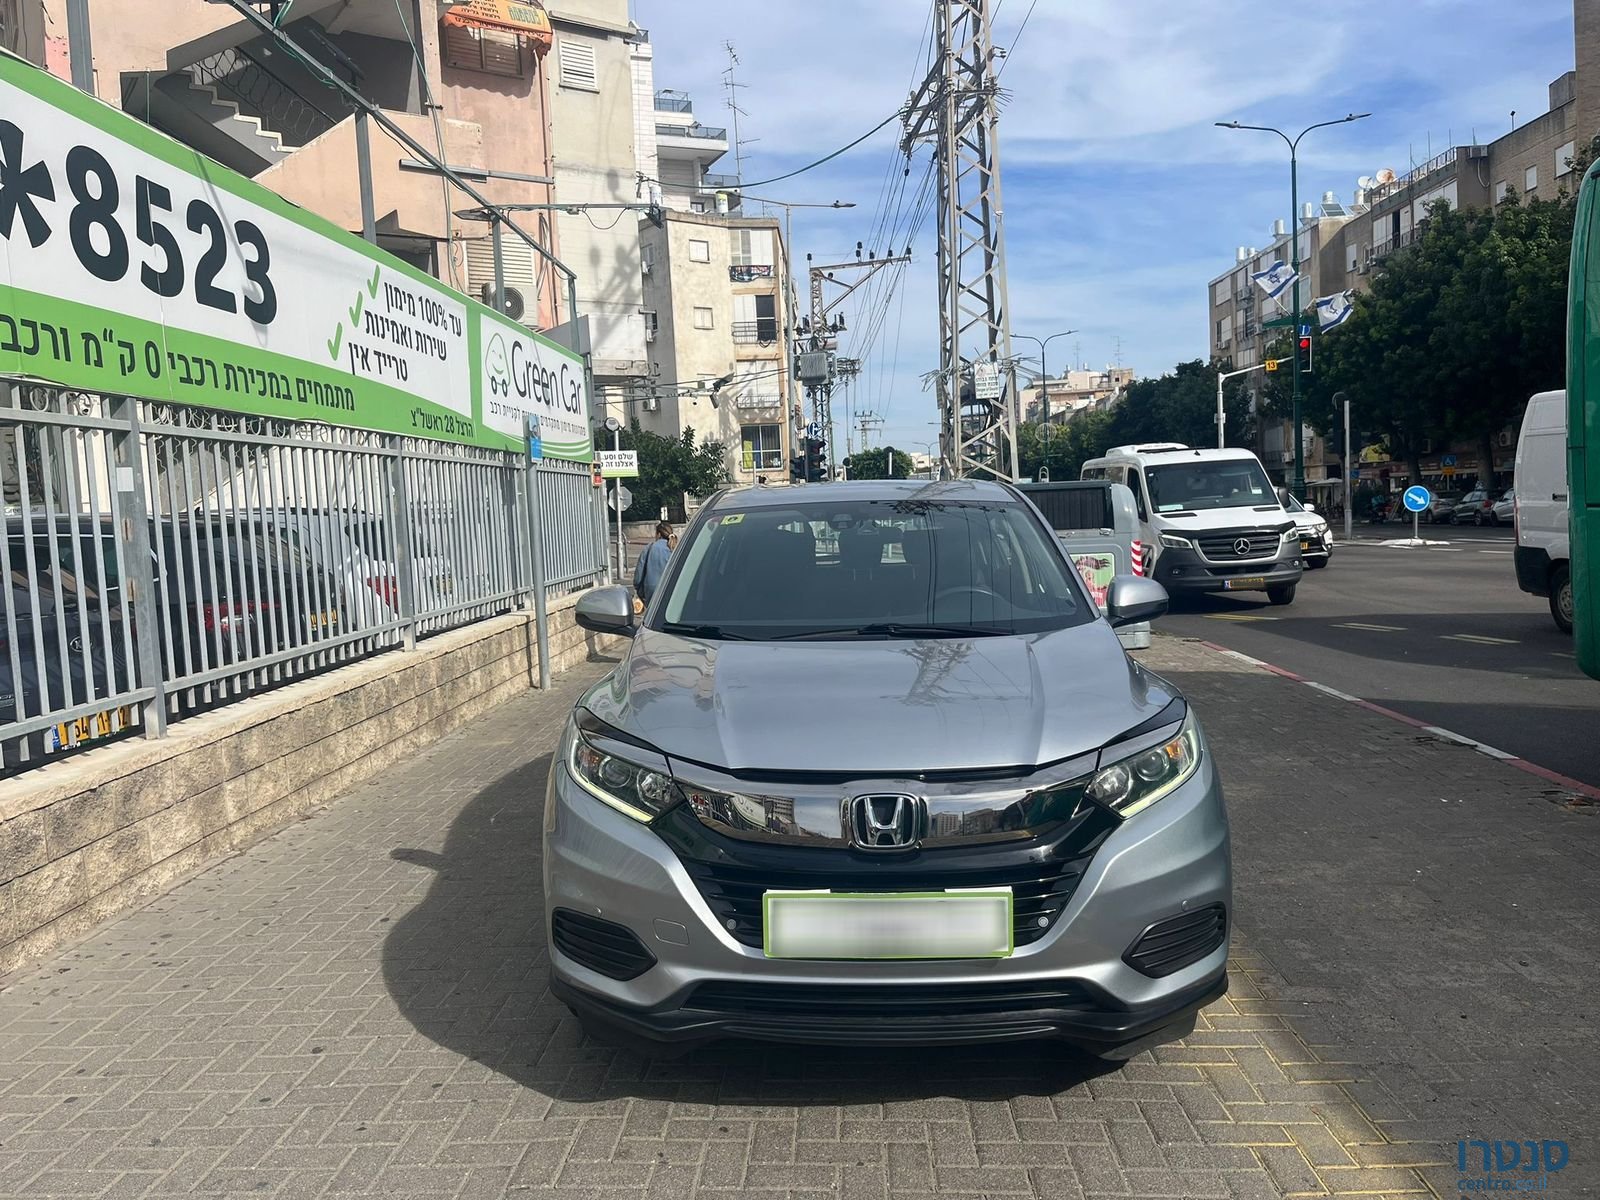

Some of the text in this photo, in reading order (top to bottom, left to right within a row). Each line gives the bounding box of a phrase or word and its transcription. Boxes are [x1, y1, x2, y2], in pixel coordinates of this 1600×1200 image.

[384, 282, 462, 337] עד 100% מימון
[364, 310, 447, 361] שירות ואמינות
[145, 340, 160, 379] 0
[169, 351, 219, 389] רכבי
[348, 342, 408, 382] טרייד אין
[512, 340, 581, 415] Green Car
[1267, 361, 1276, 369] 13
[223, 363, 292, 401] במכירת
[296, 377, 355, 411] מתמחים
[444, 414, 455, 434] 28
[455, 416, 473, 438] הרצל
[490, 401, 502, 416] רכב
[617, 452, 633, 460] שלם
